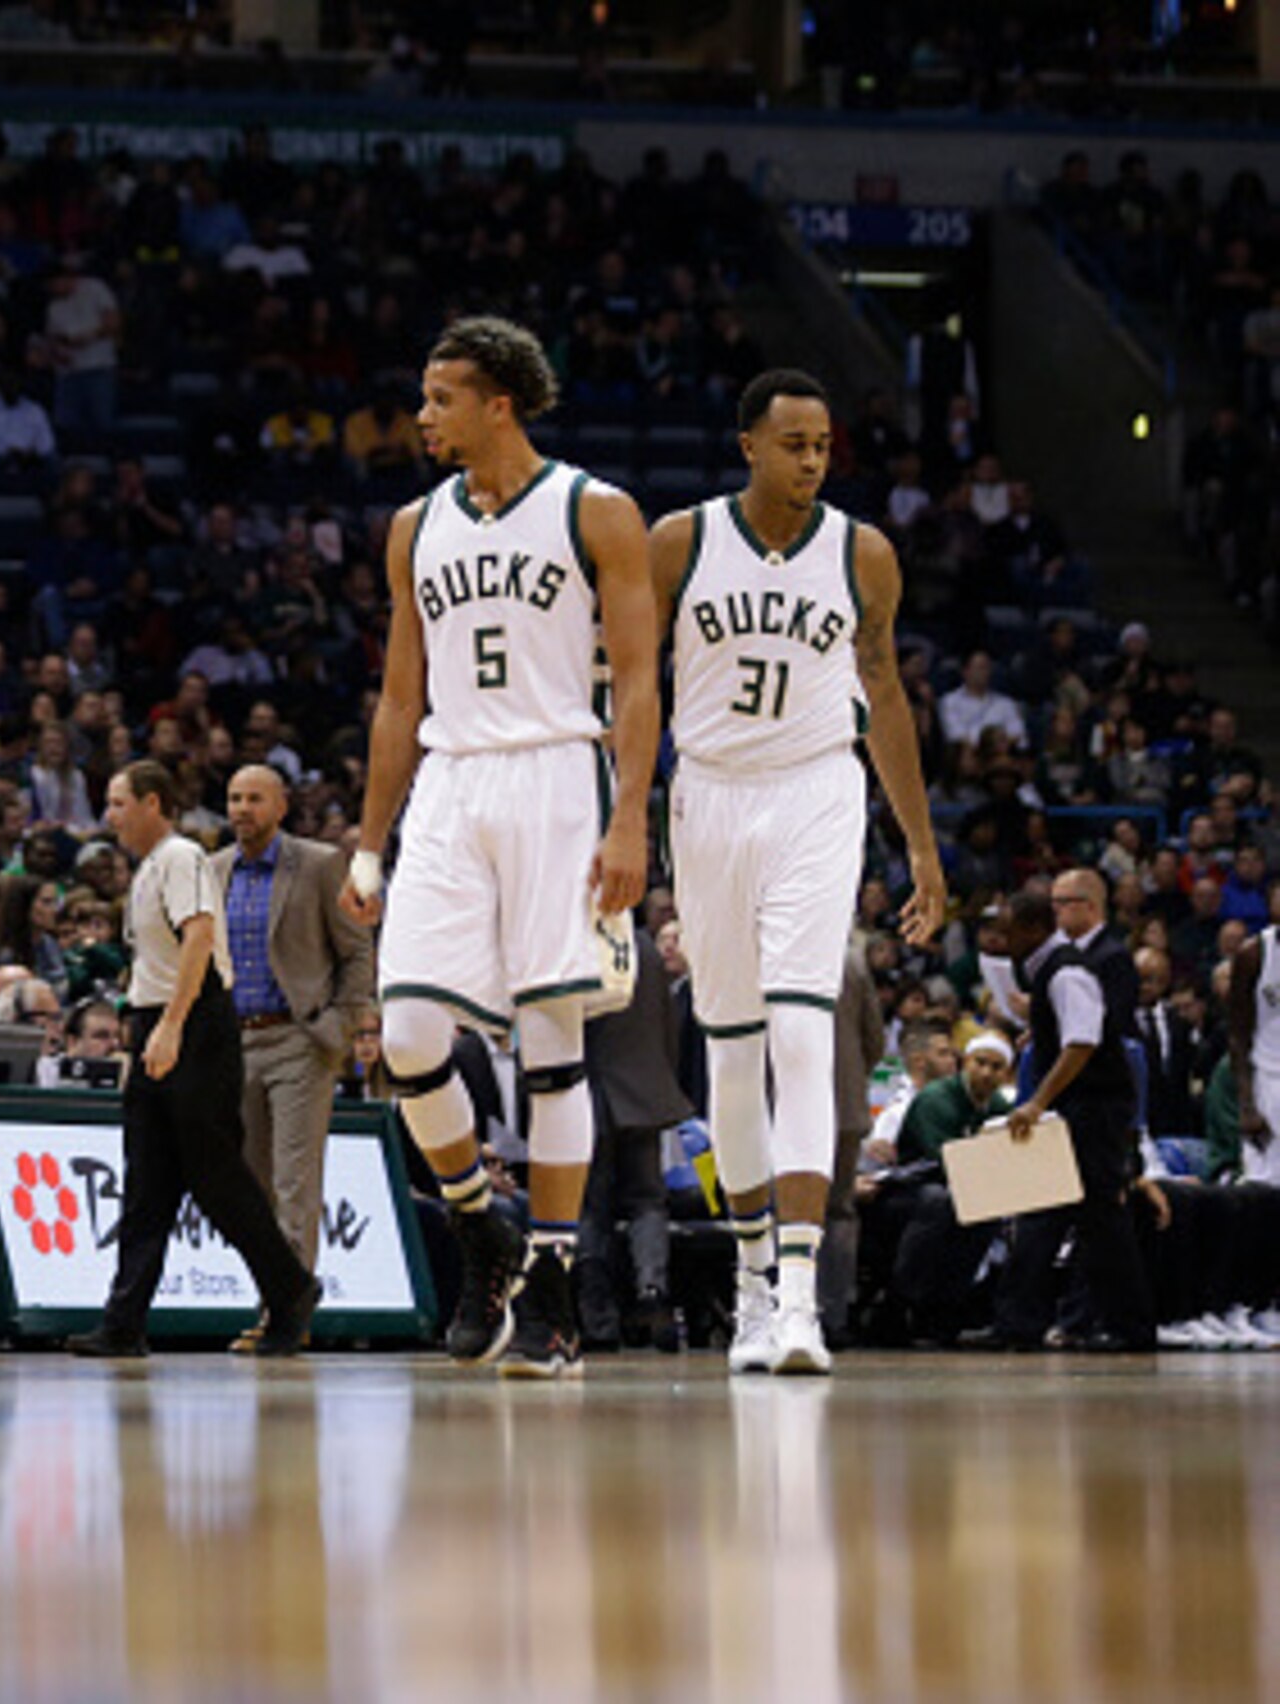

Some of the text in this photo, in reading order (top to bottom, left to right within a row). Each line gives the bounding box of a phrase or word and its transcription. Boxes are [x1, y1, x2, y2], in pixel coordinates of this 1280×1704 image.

[908, 209, 971, 247] 205
[419, 551, 567, 622] BUCKS
[693, 590, 846, 653] BUCKS
[473, 625, 507, 688] 5
[731, 656, 789, 720] 31
